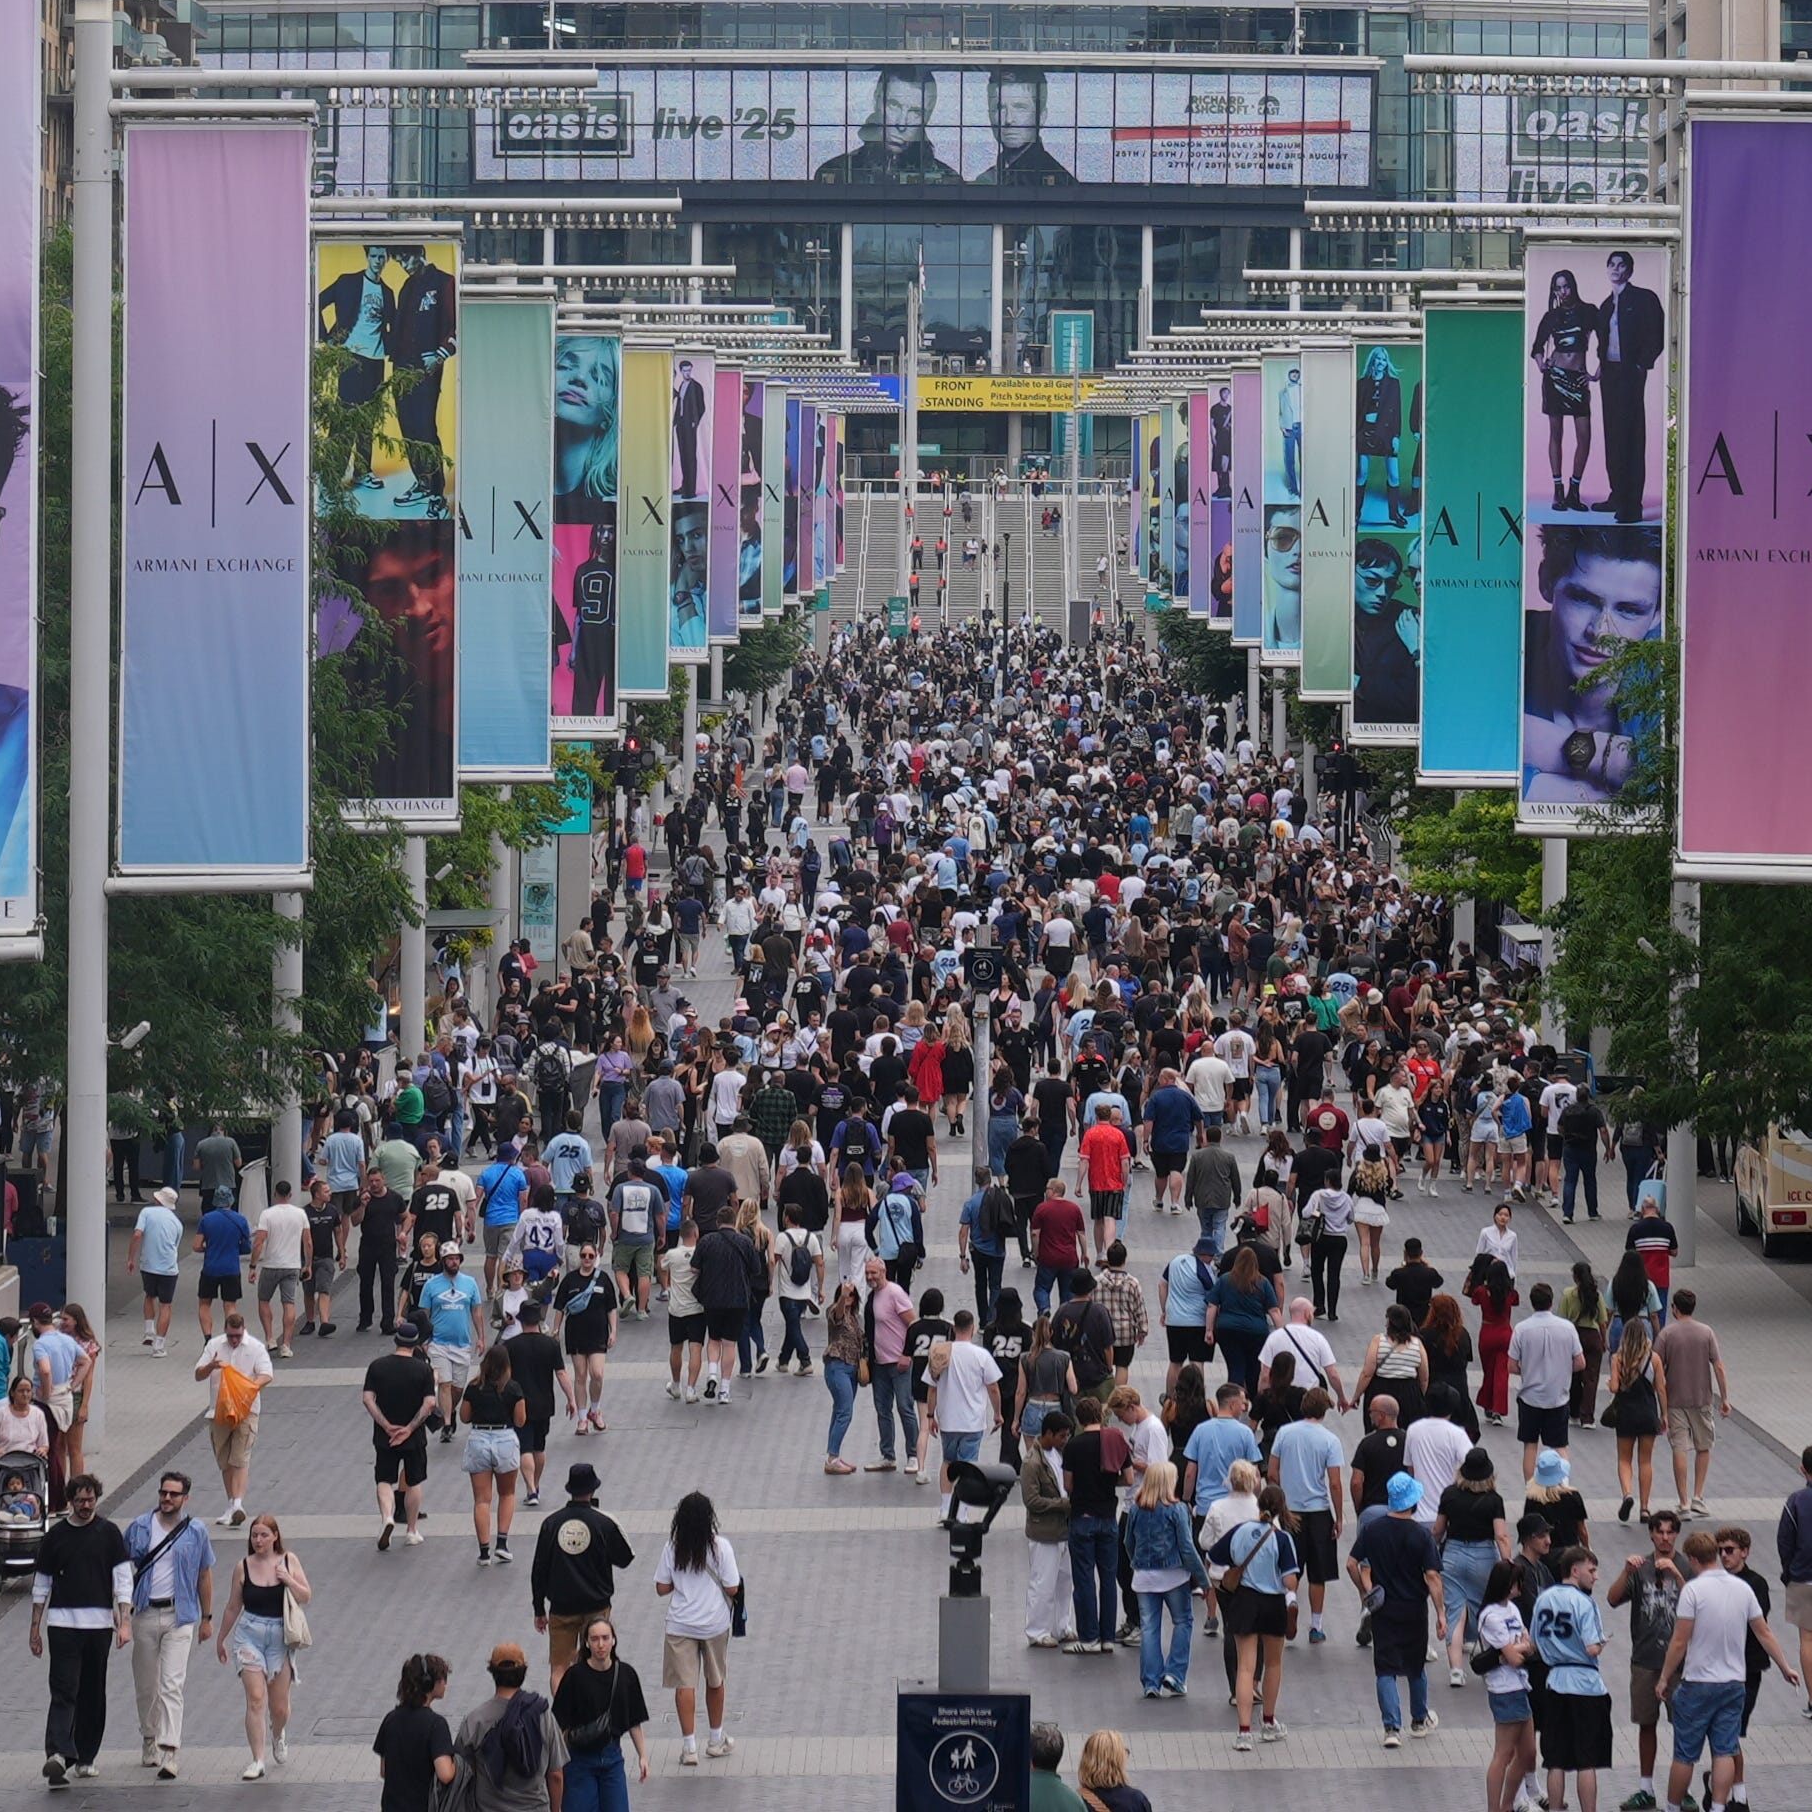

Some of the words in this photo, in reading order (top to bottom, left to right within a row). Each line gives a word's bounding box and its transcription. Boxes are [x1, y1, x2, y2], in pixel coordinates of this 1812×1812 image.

[1191, 96, 1245, 105] RICHARD
[1184, 104, 1249, 115] ASHCROFT
[1258, 107, 1280, 115] CAST
[507, 109, 620, 140] oasis
[652, 108, 724, 140] live
[1200, 125, 1235, 137] SOLD
[1237, 124, 1263, 136] OUT
[934, 381, 973, 391] FRONT
[991, 379, 1031, 389] Available
[1032, 380, 1042, 388] to
[1043, 380, 1053, 388] all
[925, 397, 984, 408] STANDING
[990, 392, 1013, 401] Pitch
[1014, 393, 1052, 403] Standing
[1695, 547, 1759, 563] ARMANI
[134, 558, 197, 573] ARMANI
[206, 558, 296, 573] EXCHANGE
[488, 572, 544, 583] EXCHANGE
[1428, 579, 1470, 589] ARMANI
[1357, 723, 1392, 733] ARMANI
[378, 799, 448, 811] EXCHANGE
[940, 957, 957, 968] 25
[796, 982, 812, 994] 25
[1332, 981, 1351, 993] 25
[559, 1144, 581, 1159] 25
[425, 1193, 450, 1210] 25
[1788, 1190, 1802, 1201] ICE
[529, 1227, 554, 1248] 42
[992, 1335, 1023, 1359] 25
[1538, 1608, 1574, 1640] 25
[938, 1707, 958, 1716] Share
[959, 1707, 975, 1716] with
[932, 1717, 970, 1726] Pedestrian
[971, 1718, 998, 1727] Priority
